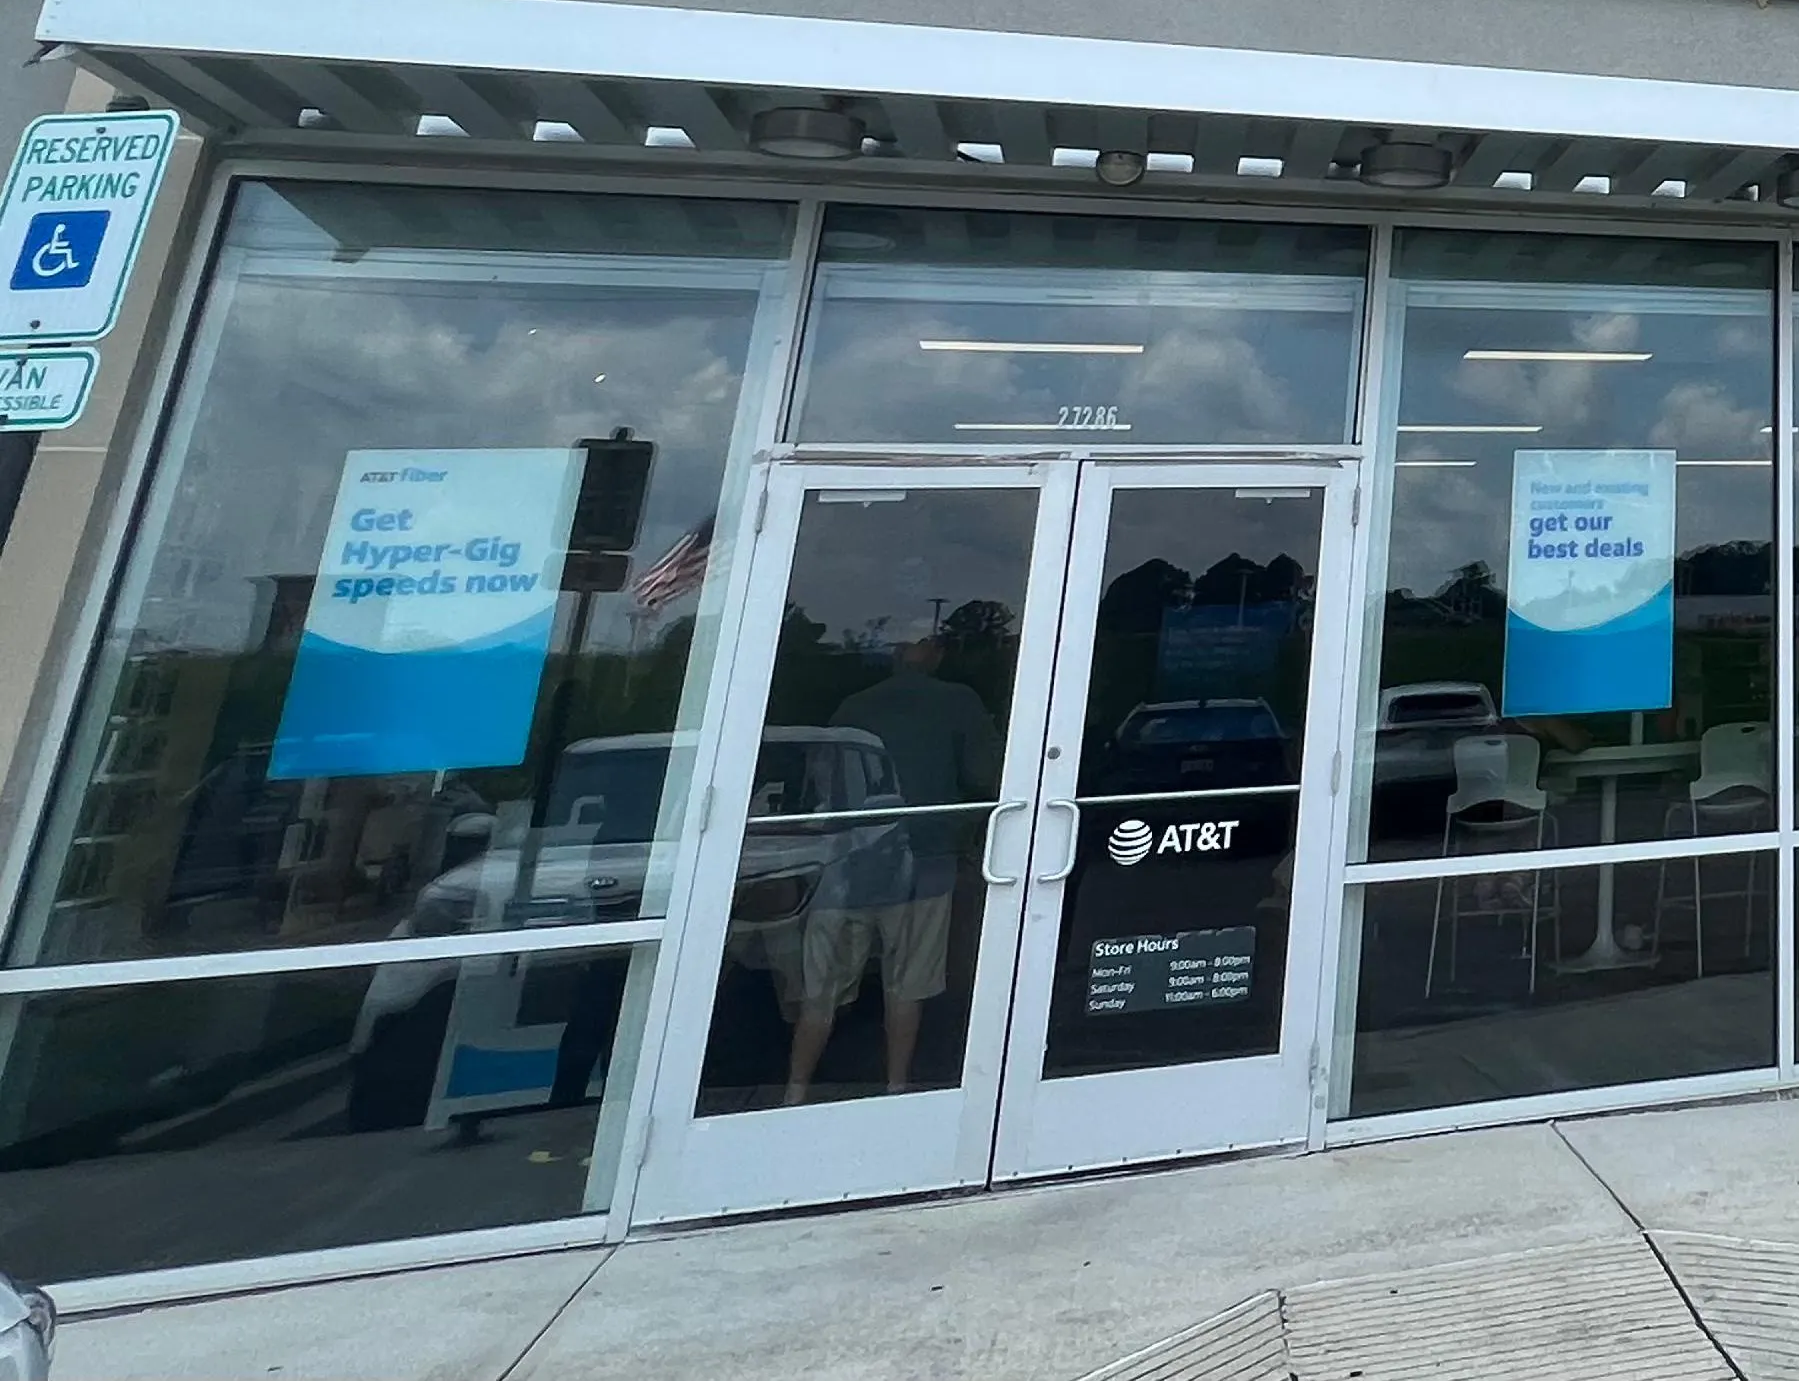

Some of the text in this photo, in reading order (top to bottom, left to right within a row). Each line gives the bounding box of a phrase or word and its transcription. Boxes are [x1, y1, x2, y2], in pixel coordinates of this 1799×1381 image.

[26, 134, 160, 165] RESERVED
[22, 172, 140, 202] PARKING
[0, 394, 62, 411] SSIBLE
[1058, 406, 1118, 427] 27286
[360, 471, 398, 483] AT&T
[350, 507, 414, 532] Get
[1529, 513, 1613, 537] get our
[340, 536, 522, 570] Hyper-Gig
[1527, 537, 1644, 559] best deals
[332, 569, 539, 604] speeds now
[1157, 820, 1240, 854] AT&T
[1095, 938, 1179, 957] Store Hours
[1090, 982, 1136, 995] Saturday
[1089, 998, 1126, 1011] Sunday
